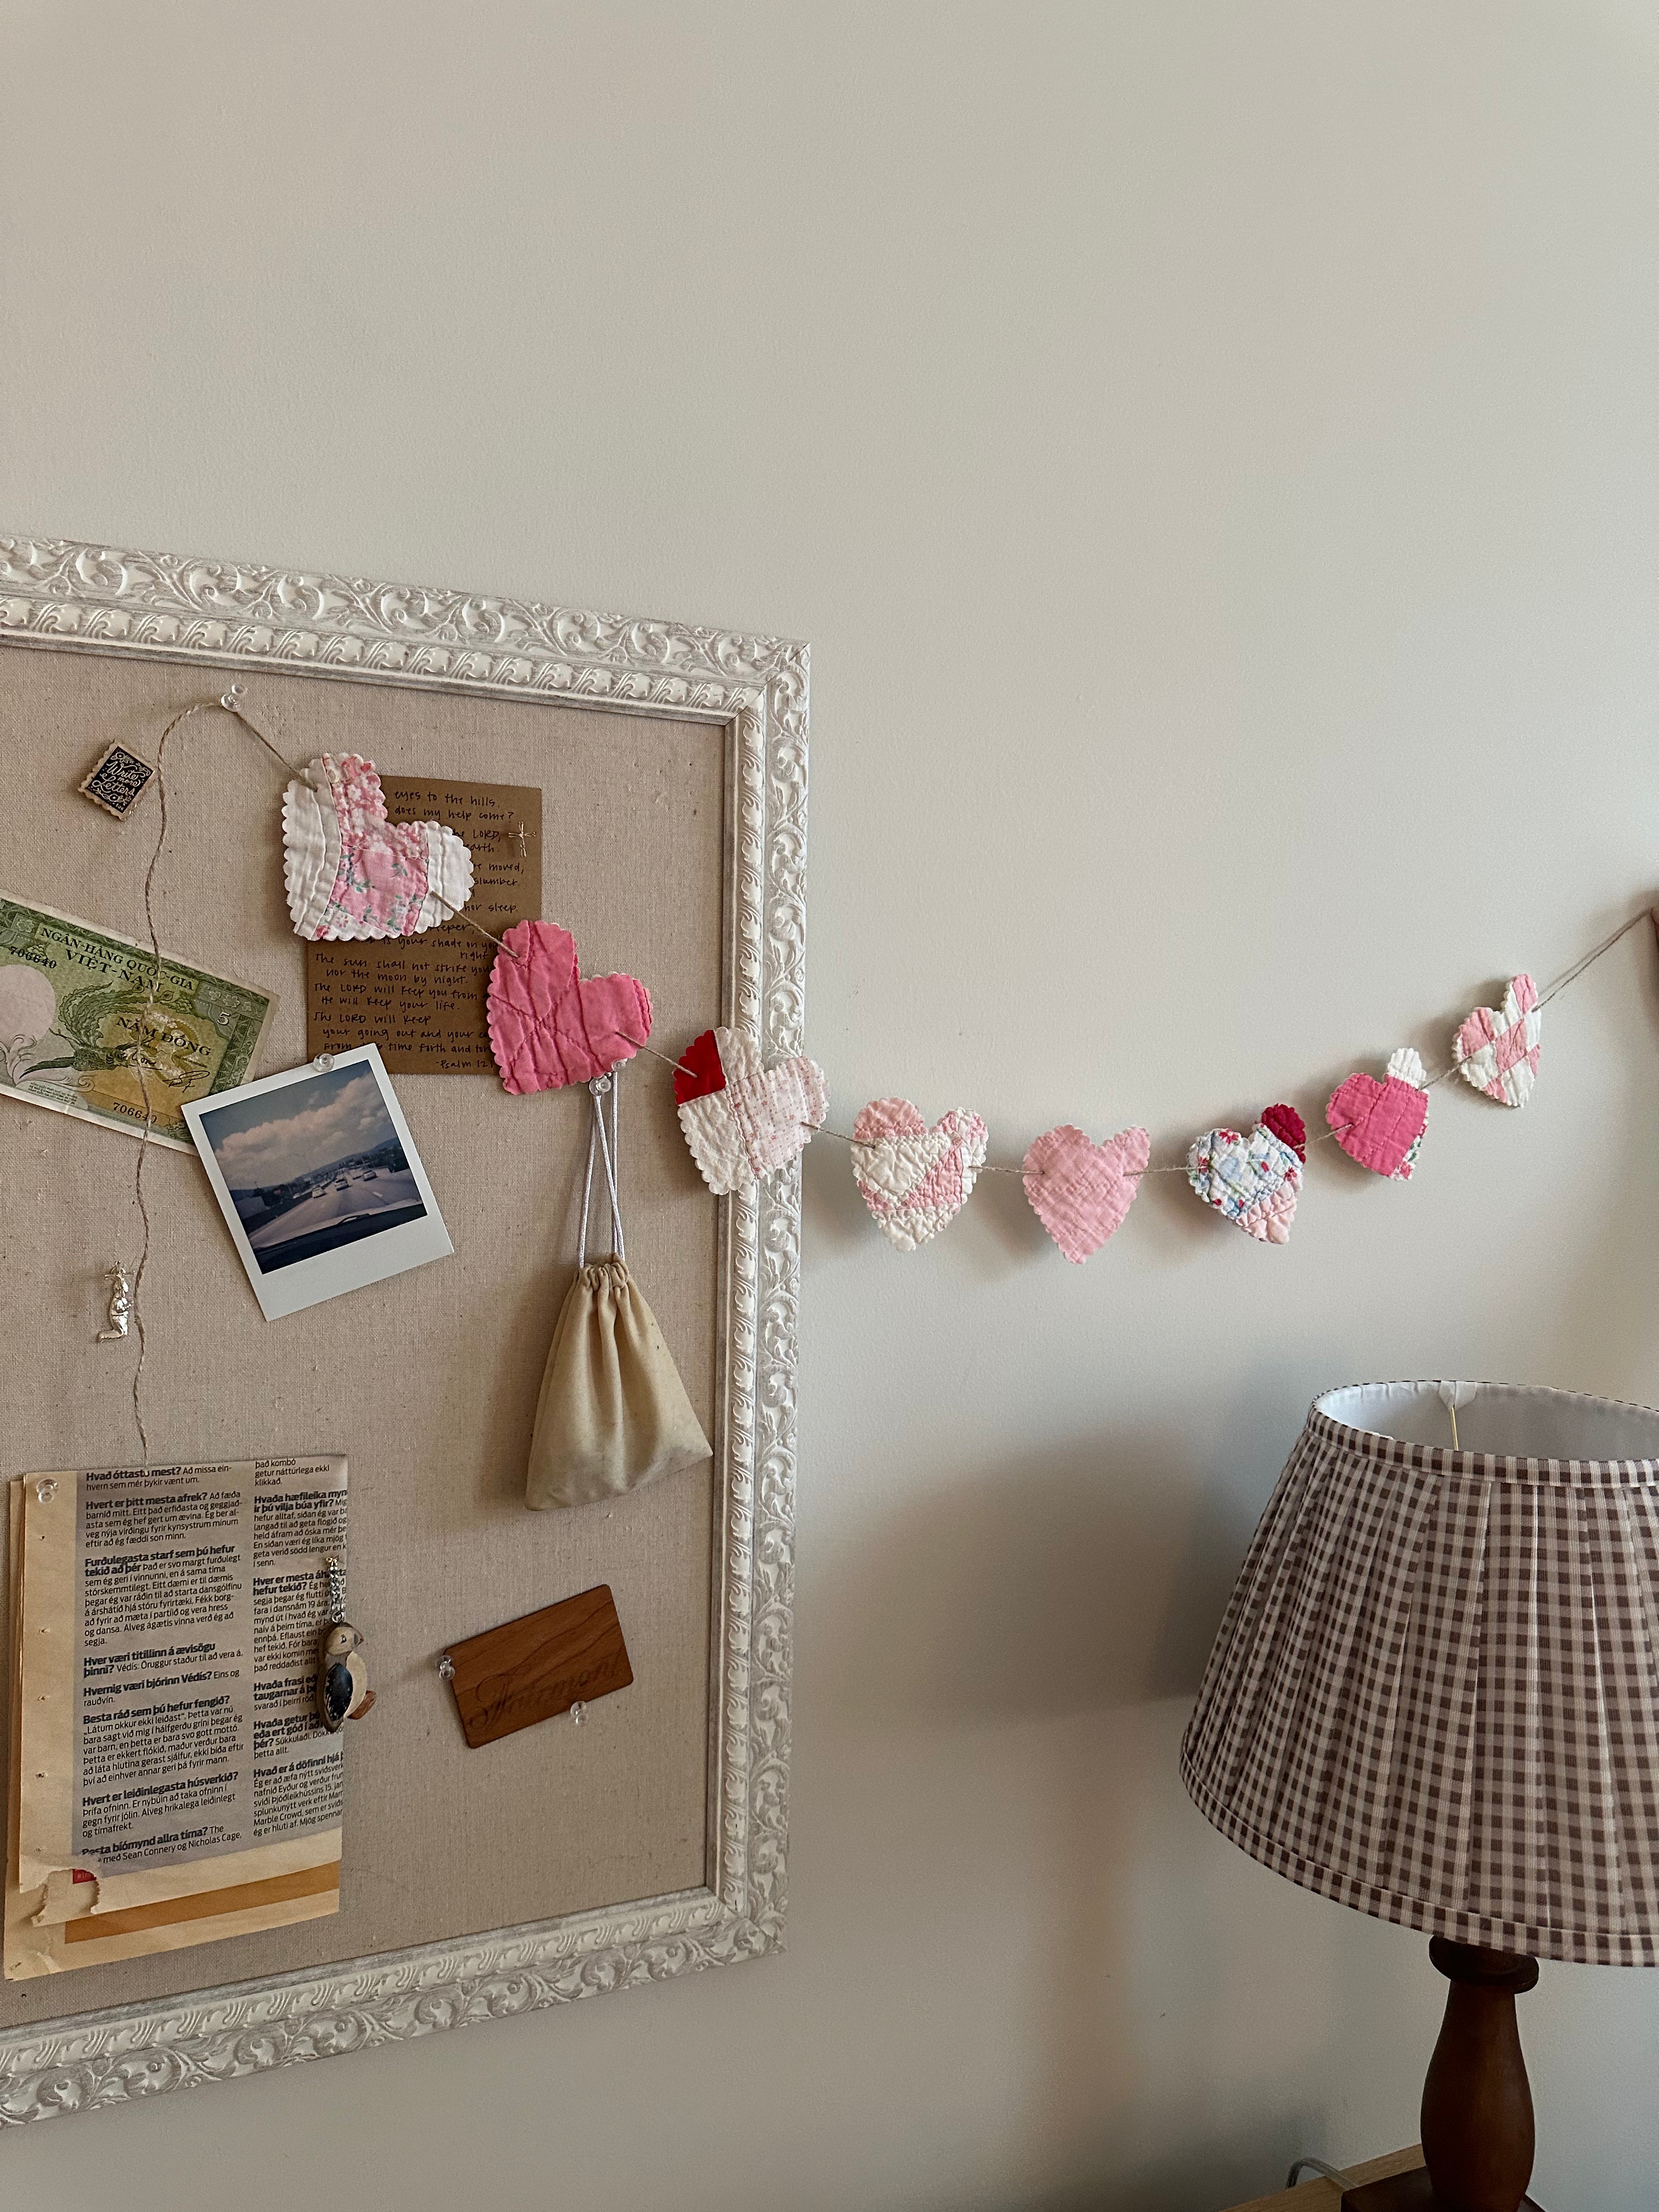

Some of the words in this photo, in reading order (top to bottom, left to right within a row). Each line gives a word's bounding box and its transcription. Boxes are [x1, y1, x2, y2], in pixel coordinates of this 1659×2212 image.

[106, 761, 145, 780] Write
[92, 773, 135, 796] Letters
[117, 777, 140, 787] more
[394, 791, 420, 801] eyes
[427, 792, 437, 802] to
[445, 793, 463, 804] the
[395, 805, 416, 815] does
[424, 809, 440, 819] my
[448, 810, 471, 821] help
[479, 811, 514, 823] come?
[473, 829, 501, 842] LORD,
[489, 863, 523, 874] moved,
[398, 938, 427, 949] your
[431, 939, 461, 947] shade
[10, 945, 57, 969] 706640
[315, 953, 334, 963] The
[344, 958, 367, 967] sun
[376, 960, 405, 969] shall
[412, 962, 430, 970] not
[435, 963, 466, 972] strike
[461, 951, 488, 961] right
[351, 969, 369, 979] the
[377, 973, 407, 981] moon
[414, 975, 427, 986] by
[435, 976, 467, 986] night.
[315, 983, 330, 992] The
[341, 984, 366, 993] LORD
[374, 985, 394, 994] will
[430, 989, 447, 999] you
[451, 990, 477, 1000] from
[321, 996, 333, 1005] He
[400, 1001, 428, 1013] your
[436, 1000, 460, 1011] life.
[217, 1012, 230, 1025] 5
[314, 1012, 331, 1021] The
[340, 1014, 366, 1023] LORD
[375, 1014, 395, 1024] will
[323, 1029, 350, 1038] your
[358, 1029, 389, 1041] going
[397, 1029, 416, 1037] out
[421, 1029, 441, 1037] and
[448, 1031, 474, 1042] your
[419, 1043, 445, 1052] forth
[255, 1459, 269, 1470] það
[270, 1458, 296, 1466] kombó
[86, 1471, 112, 1481] Hvað
[151, 1467, 182, 1476] mest?
[182, 1466, 193, 1475] Að
[86, 1499, 113, 1509] Hvert
[126, 1497, 144, 1508] þitt
[145, 1495, 176, 1504] mesta
[177, 1492, 207, 1502] afrek?
[209, 1492, 219, 1500] Að
[221, 1491, 241, 1499] fæða
[254, 1494, 283, 1503] Hvaða
[285, 1490, 326, 1501] hæfileika
[262, 1503, 273, 1514] þú
[275, 1502, 294, 1512] vilja
[295, 1500, 312, 1509] búa
[86, 1554, 149, 1567] Furðulegasta
[150, 1550, 173, 1560] starf
[196, 1547, 208, 1558] þú
[210, 1545, 235, 1555] hefur
[252, 1578, 274, 1586] Hver
[285, 1572, 315, 1582] mesta
[252, 1586, 277, 1595] hefur
[279, 1582, 307, 1593] tekið?
[84, 1658, 106, 1666] Hver
[109, 1653, 130, 1663] væri
[168, 1647, 174, 1656] á
[84, 1664, 114, 1678] þinni?
[140, 1660, 171, 1669] Öruggur
[173, 1656, 198, 1664] staður
[207, 1652, 217, 1661] að
[123, 1680, 144, 1691] væri
[146, 1677, 180, 1689] bjórinn
[182, 1671, 212, 1683] Védís?
[83, 1713, 112, 1724] Besta
[113, 1710, 130, 1720] ráð
[153, 1705, 166, 1716] þú
[167, 1703, 192, 1712] hefur
[194, 1696, 230, 1708] fengið?
[253, 1765, 277, 1777] Hvað
[289, 1762, 294, 1770] á
[327, 1753, 340, 1764] hjá
[82, 1794, 111, 1806] Hvert
[253, 1814, 279, 1825] Marble
[157, 1835, 179, 1844] allra
[181, 1828, 206, 1840] tíma?
[207, 1826, 224, 1835] The
[103, 1853, 122, 1863] með
[121, 1852, 142, 1860] Sean
[144, 1845, 176, 1855] Connery
[188, 1837, 221, 1848] Nicholas
